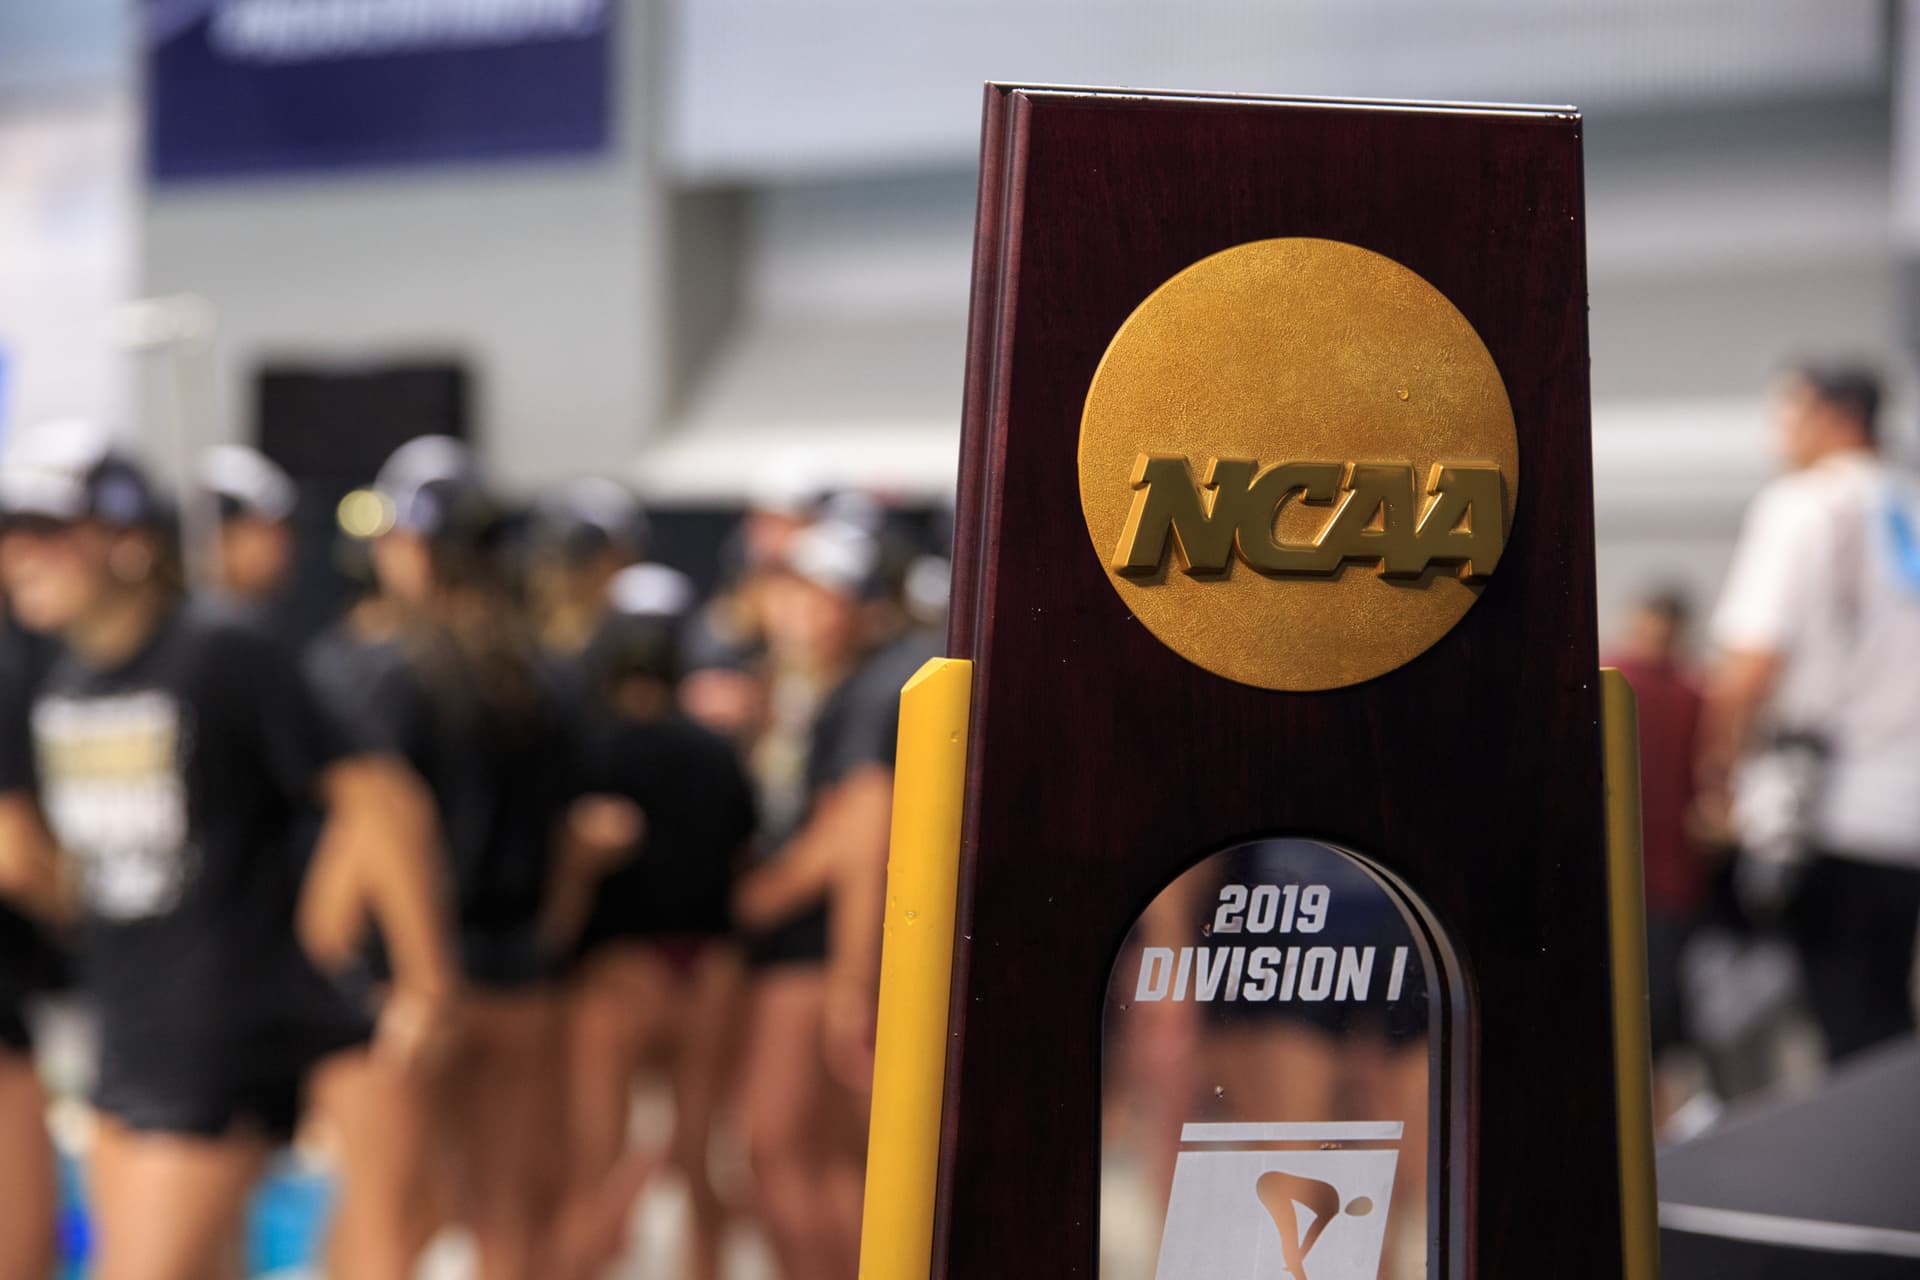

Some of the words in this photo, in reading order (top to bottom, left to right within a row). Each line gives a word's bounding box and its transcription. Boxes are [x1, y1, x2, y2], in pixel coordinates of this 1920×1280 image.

[1112, 452, 1503, 583] NCAA
[1213, 884, 1331, 934] 2019
[1134, 946, 1376, 1002] DIVISION
[1387, 946, 1409, 1001] I
